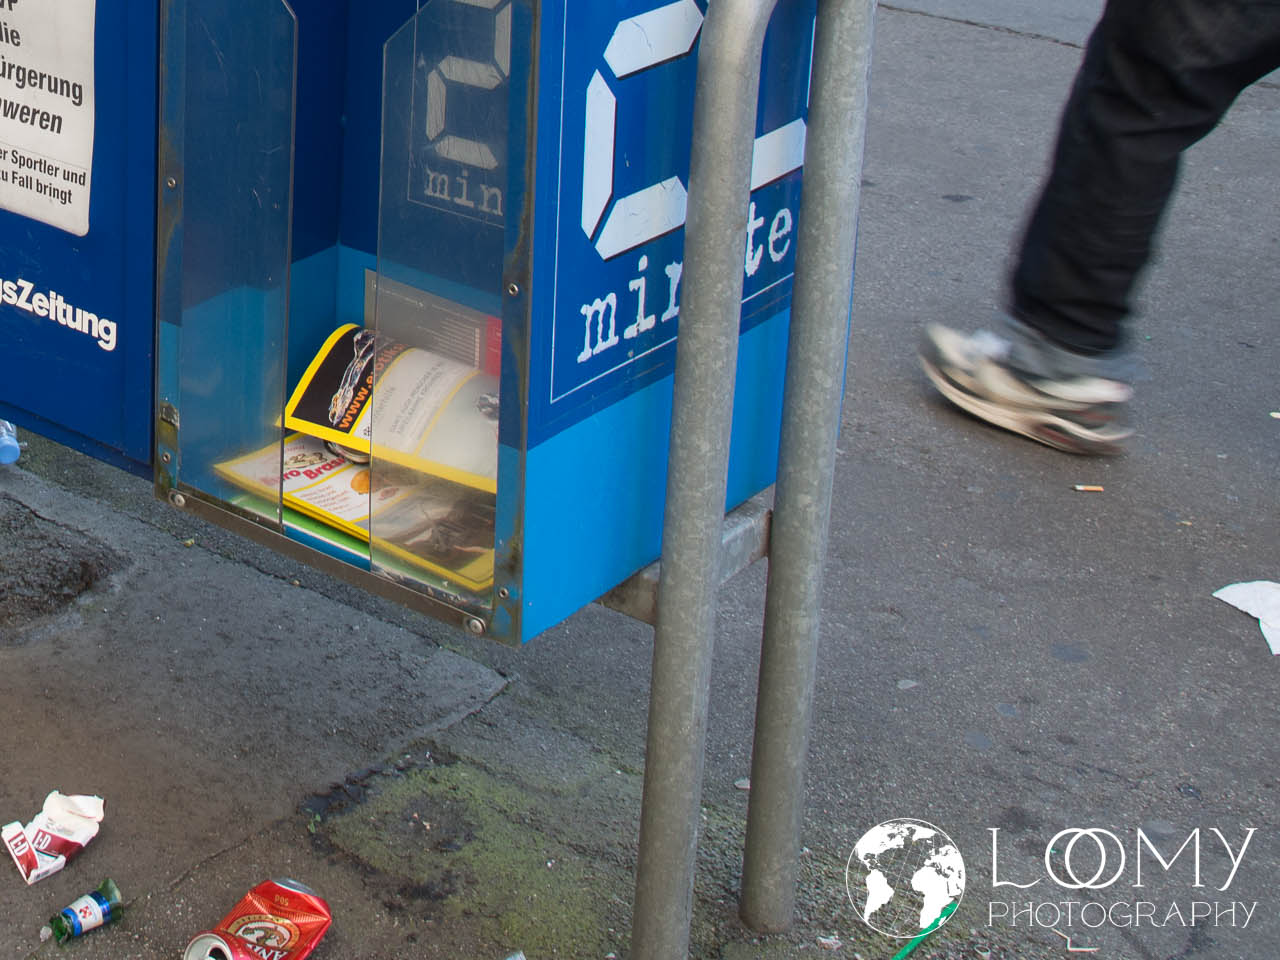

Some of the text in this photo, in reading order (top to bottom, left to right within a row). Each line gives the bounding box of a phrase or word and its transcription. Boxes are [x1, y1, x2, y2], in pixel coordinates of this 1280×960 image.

[10, 149, 60, 178] Sportler
[62, 167, 87, 187] und
[11, 170, 34, 190] Fall
[36, 178, 73, 205] bringt
